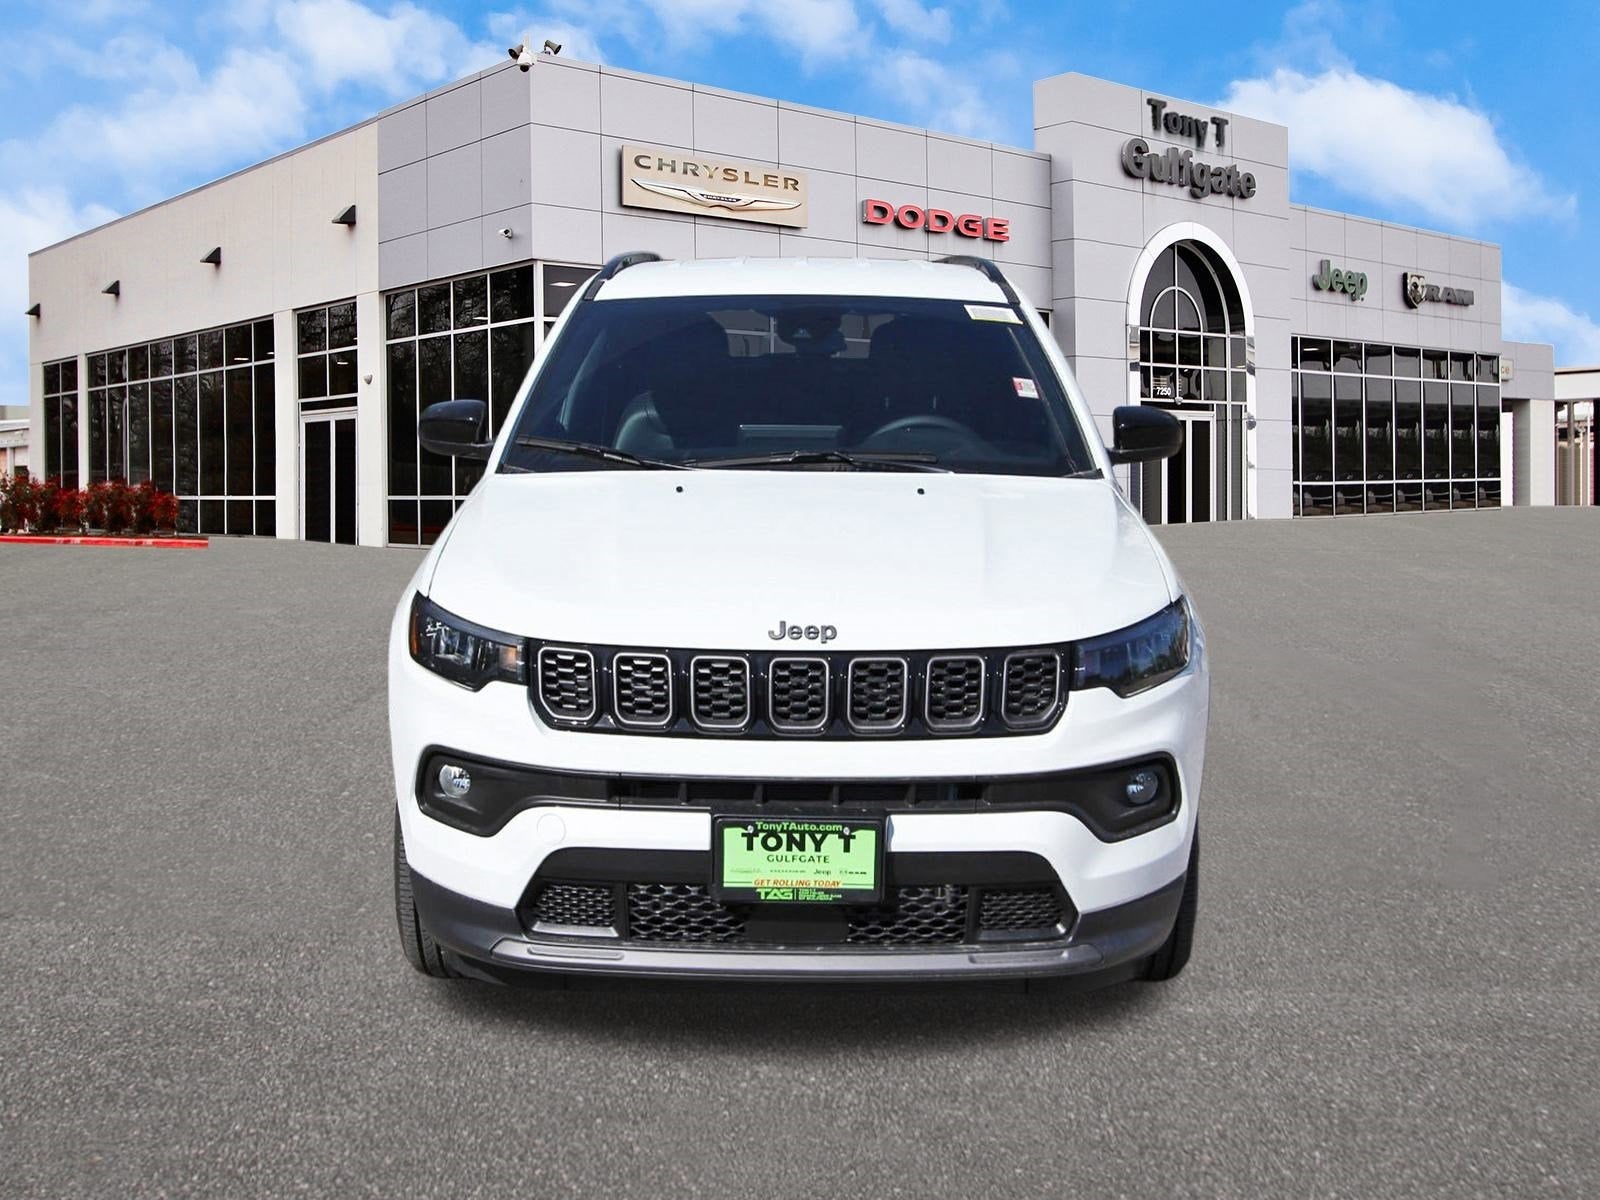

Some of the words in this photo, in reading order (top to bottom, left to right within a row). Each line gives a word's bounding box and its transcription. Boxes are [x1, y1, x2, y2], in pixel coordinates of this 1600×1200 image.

[1146, 98, 1208, 147] Tony
[1210, 116, 1229, 147] T
[634, 154, 800, 192] CHRYSLER
[1121, 138, 1257, 199] Gulfgate
[862, 199, 1010, 243] DODGE
[1312, 259, 1368, 302] Jeep
[1425, 284, 1475, 306] RAM
[1156, 387, 1171, 396] 7250
[768, 620, 837, 644] Jeep
[756, 821, 843, 834] TonyTAuto.com
[741, 832, 830, 852] TONY
[838, 834, 856, 853] T
[766, 854, 830, 864] GULFGATE
[754, 879, 771, 887] GET
[773, 879, 811, 888] ROLLING
[813, 880, 843, 888] TODAY
